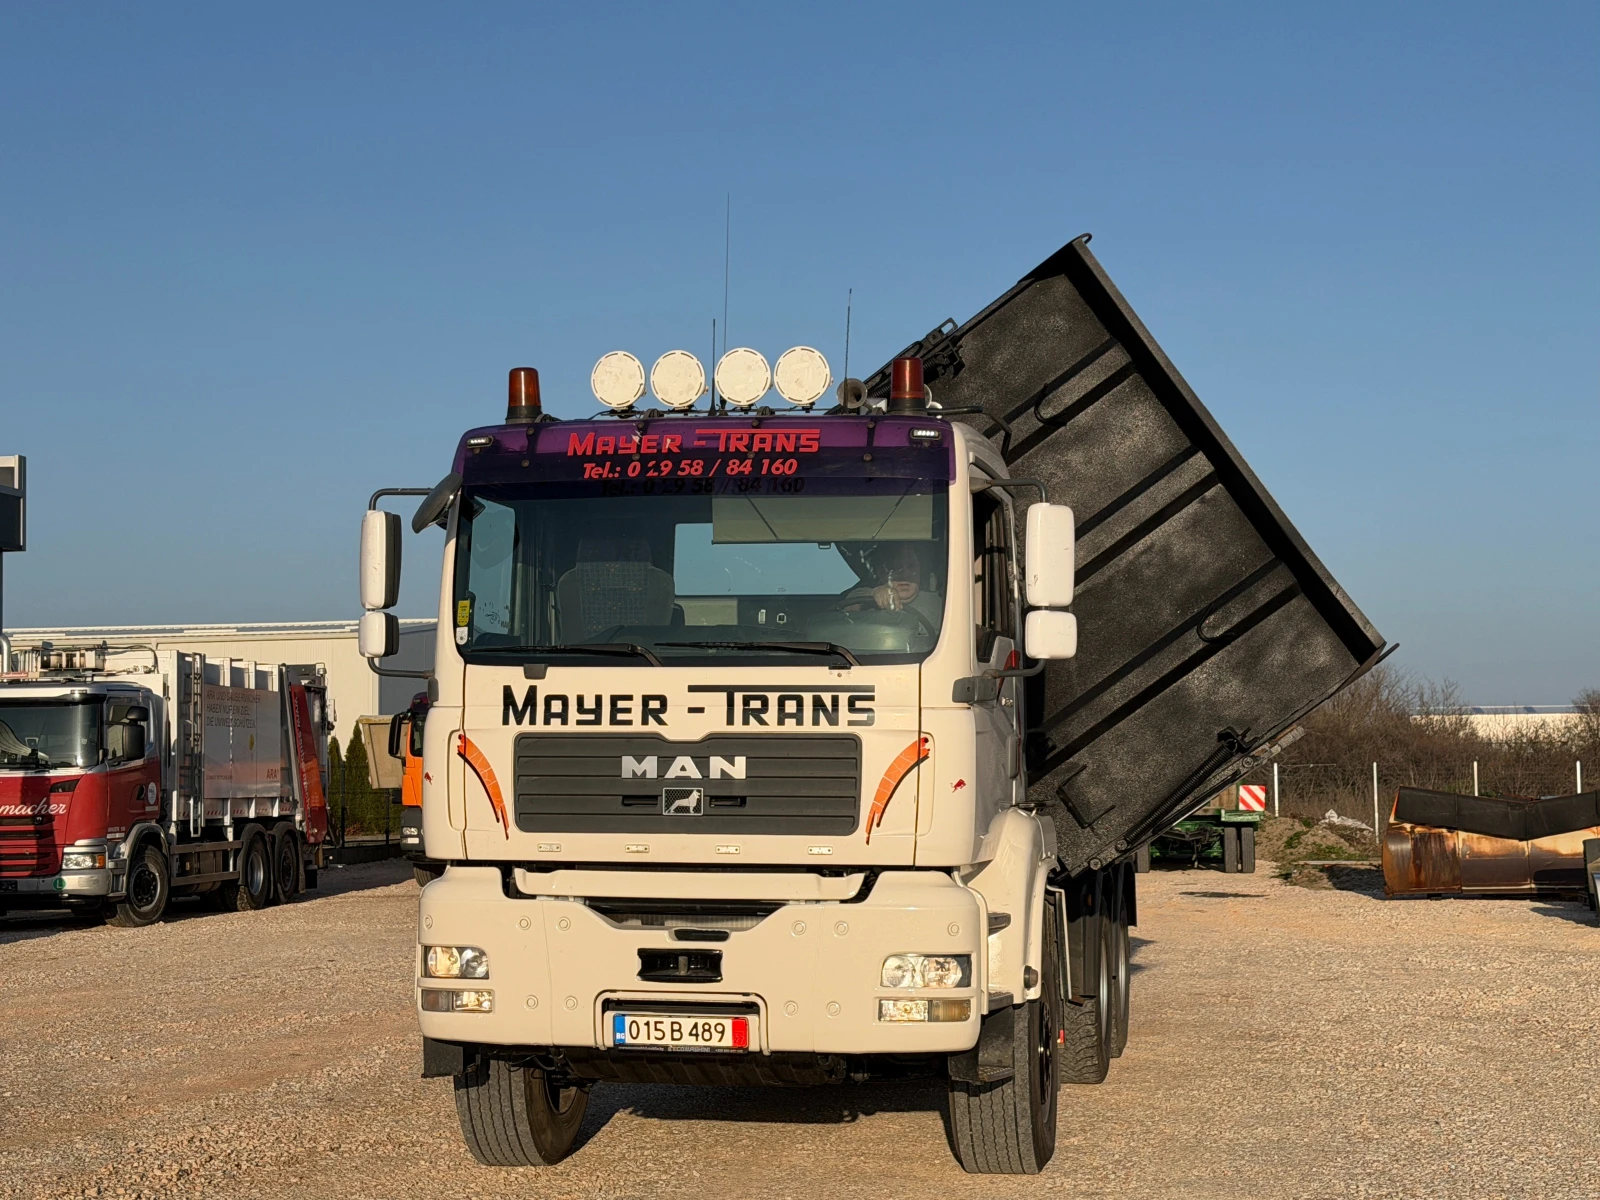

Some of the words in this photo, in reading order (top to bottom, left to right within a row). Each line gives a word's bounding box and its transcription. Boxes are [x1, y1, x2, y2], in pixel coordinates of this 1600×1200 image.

[567, 432, 683, 456] MAYER
[582, 462, 621, 479] Tel.:
[627, 462, 641, 477] 0
[646, 460, 673, 477] 29
[677, 459, 704, 476] 58
[708, 459, 722, 477] /
[726, 459, 752, 475] 84
[761, 458, 798, 476] 160
[502, 685, 669, 726] MAYER
[621, 755, 747, 779] MAN
[616, 1032, 625, 1040] BG
[628, 1020, 666, 1041] 015
[688, 1022, 726, 1043] 489
